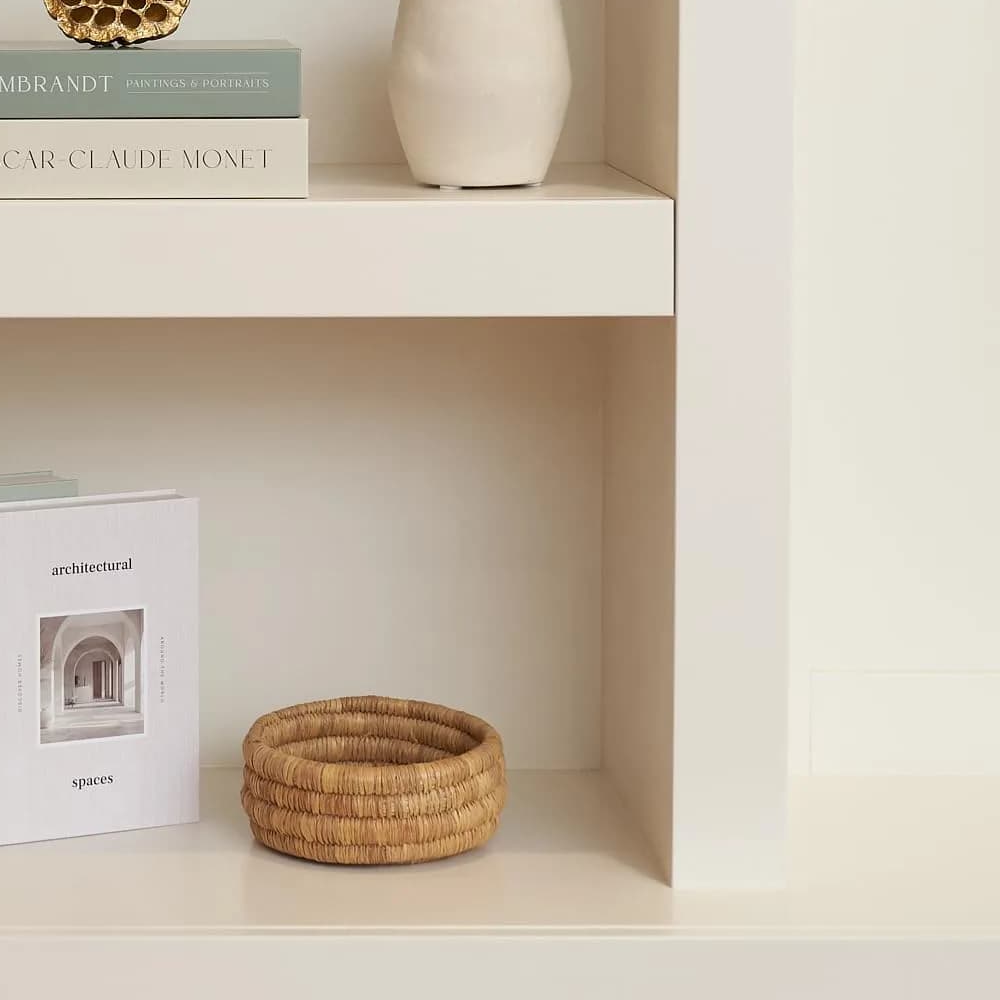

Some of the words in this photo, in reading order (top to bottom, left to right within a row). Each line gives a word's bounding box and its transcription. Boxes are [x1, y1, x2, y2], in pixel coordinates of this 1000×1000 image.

[126, 78, 186, 89] PAINTINGS
[190, 79, 198, 88] &
[202, 78, 270, 89] PORTRAITS
[182, 148, 273, 169] MONET
[51, 557, 134, 576] architectural
[71, 774, 114, 790] spaces
